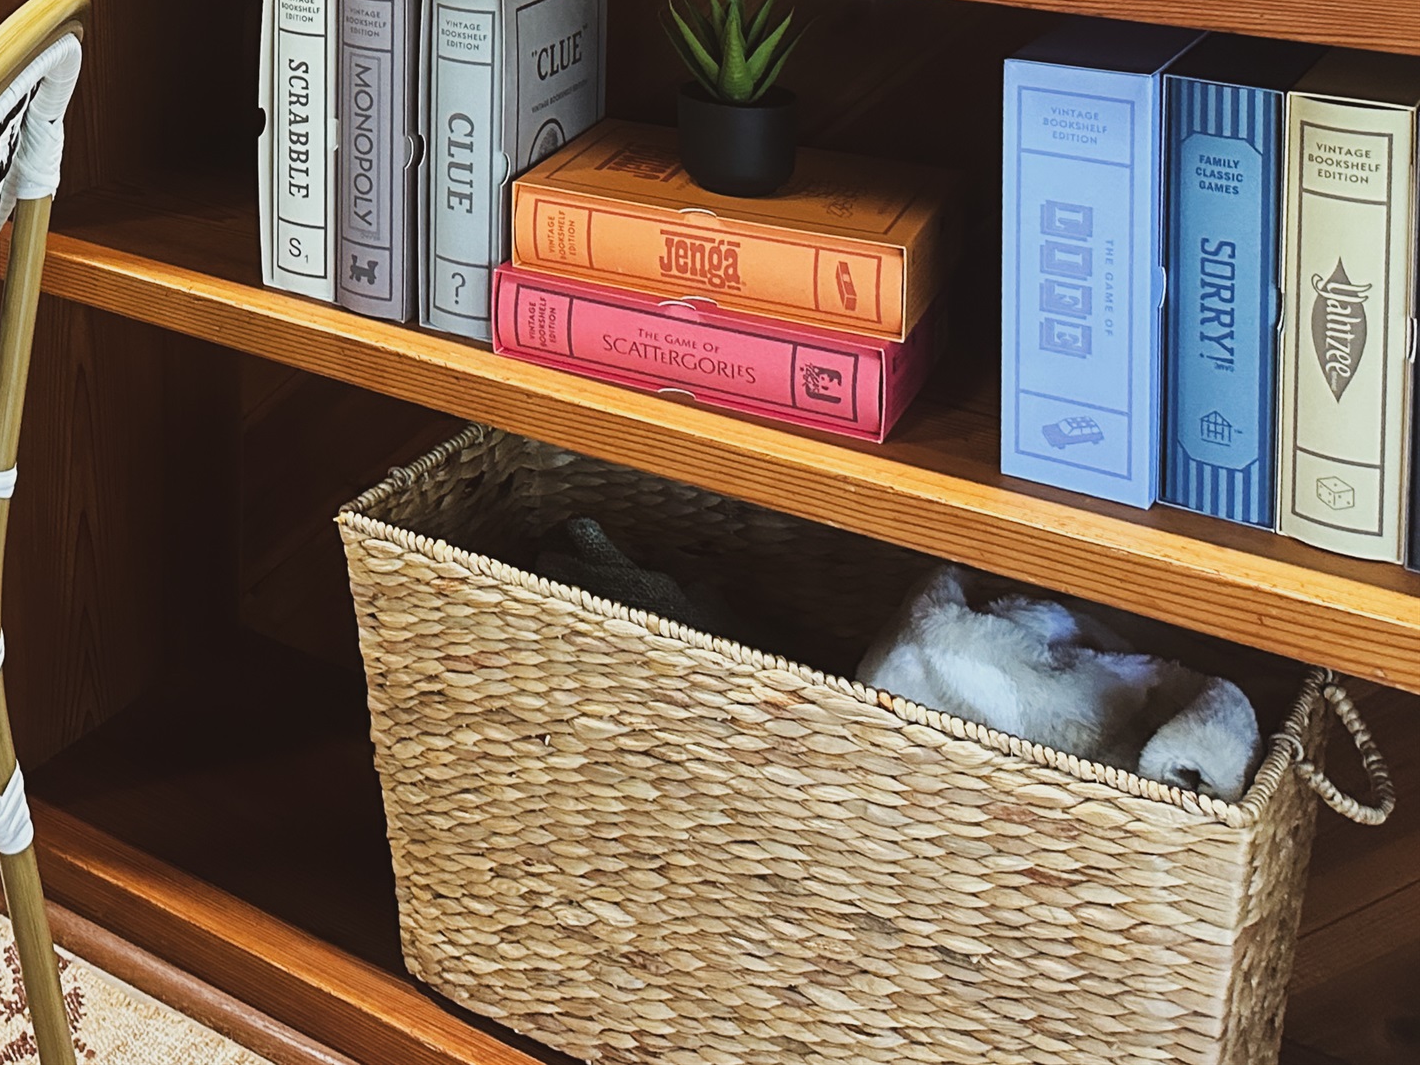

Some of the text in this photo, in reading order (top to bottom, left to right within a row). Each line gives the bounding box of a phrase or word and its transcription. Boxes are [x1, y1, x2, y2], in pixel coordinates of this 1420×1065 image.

[281, 2, 321, 15] BOOKSHELF
[285, 11, 314, 23] EDITION
[349, 7, 380, 19] VINTAGE
[346, 16, 387, 29] BOOKSHELF
[350, 26, 380, 37] EDITION
[445, 19, 482, 32] VINTAGE
[441, 28, 488, 42] BOOKSHELF
[446, 39, 480, 51] EDITION
[1050, 107, 1099, 120] VINTAGE
[288, 58, 310, 199] SCRABBLE
[1042, 117, 1108, 134] BOOKSHELF
[354, 63, 374, 226] MONOPOLY
[1052, 130, 1097, 145] EDITION
[1316, 142, 1372, 159] VINTAGE
[447, 112, 475, 215] CLUE
[1198, 154, 1240, 169] FAMILY
[1308, 153, 1381, 173] BOOKSHELF
[1195, 167, 1244, 183] CLASSIC
[1317, 168, 1370, 184] EDITION
[1198, 180, 1239, 195] GAMES
[547, 216, 555, 253] VINTAGE
[558, 210, 566, 260] BOOKSHELF
[568, 220, 576, 256] EDITION
[659, 237, 741, 289] Jenga
[1048, 203, 1087, 353] LIFE
[1105, 239, 1114, 336] THE GAME OF
[1200, 237, 1236, 365] SORRY!
[528, 301, 536, 340] VINTAGE
[538, 296, 547, 347] BOOKSHELF
[549, 307, 557, 343] EDITION
[1311, 273, 1373, 378] Yahtzee
[638, 328, 720, 354] THE GAME OF
[602, 334, 757, 384] SCATTERGORIES
